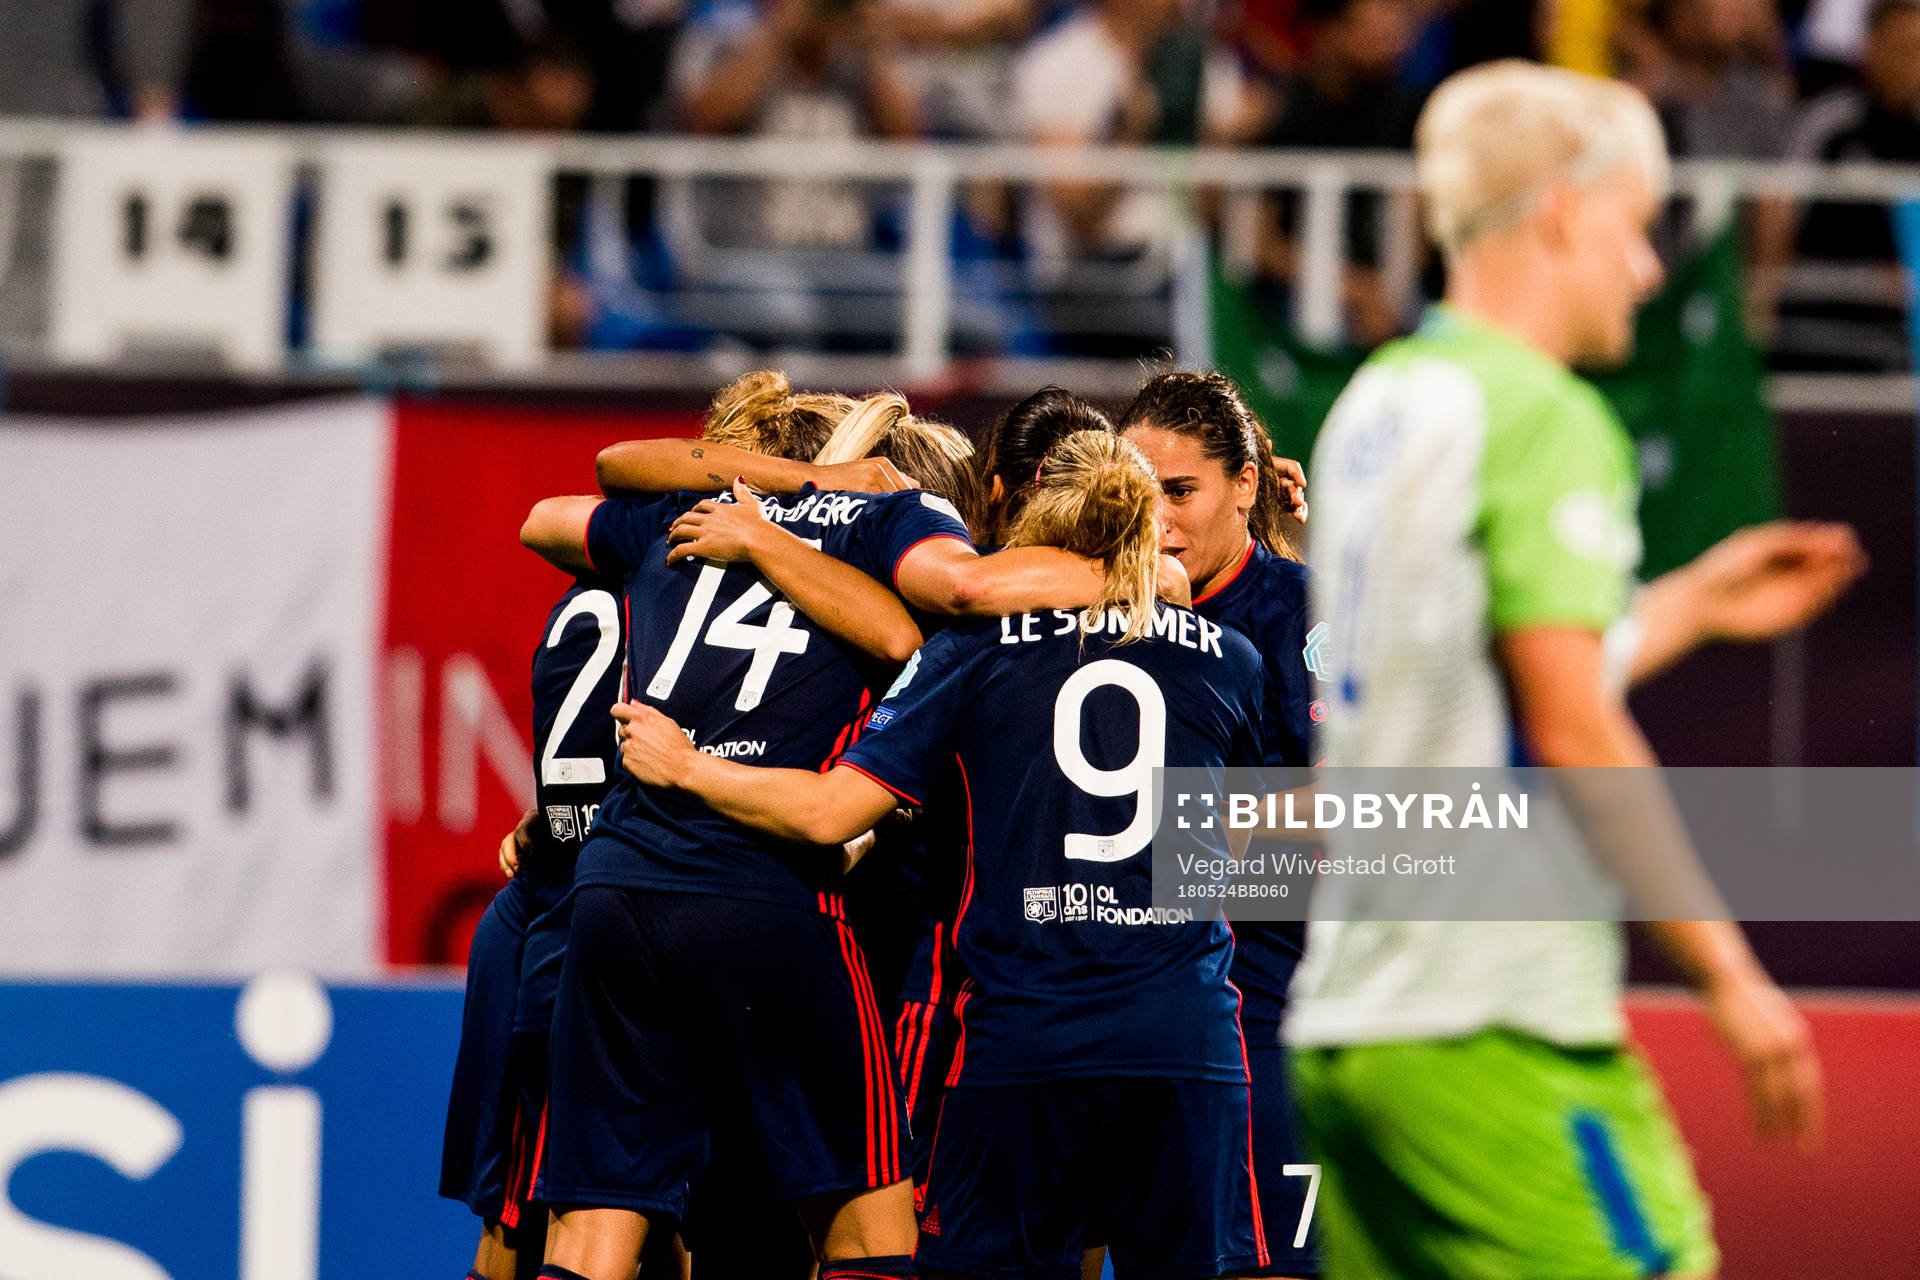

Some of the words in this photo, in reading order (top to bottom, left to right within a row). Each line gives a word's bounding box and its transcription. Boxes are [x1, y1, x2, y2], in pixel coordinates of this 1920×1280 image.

[121, 192, 236, 263] 14
[645, 537, 823, 713] 14
[1000, 609, 1043, 645] LE
[541, 589, 628, 787] 2
[1053, 658, 1167, 863] 9
[1062, 883, 1088, 906] 10
[1063, 905, 1088, 916] ans
[1096, 885, 1119, 904] OL
[1096, 907, 1194, 925] FONDATION
[1283, 1164, 1321, 1248] 7
